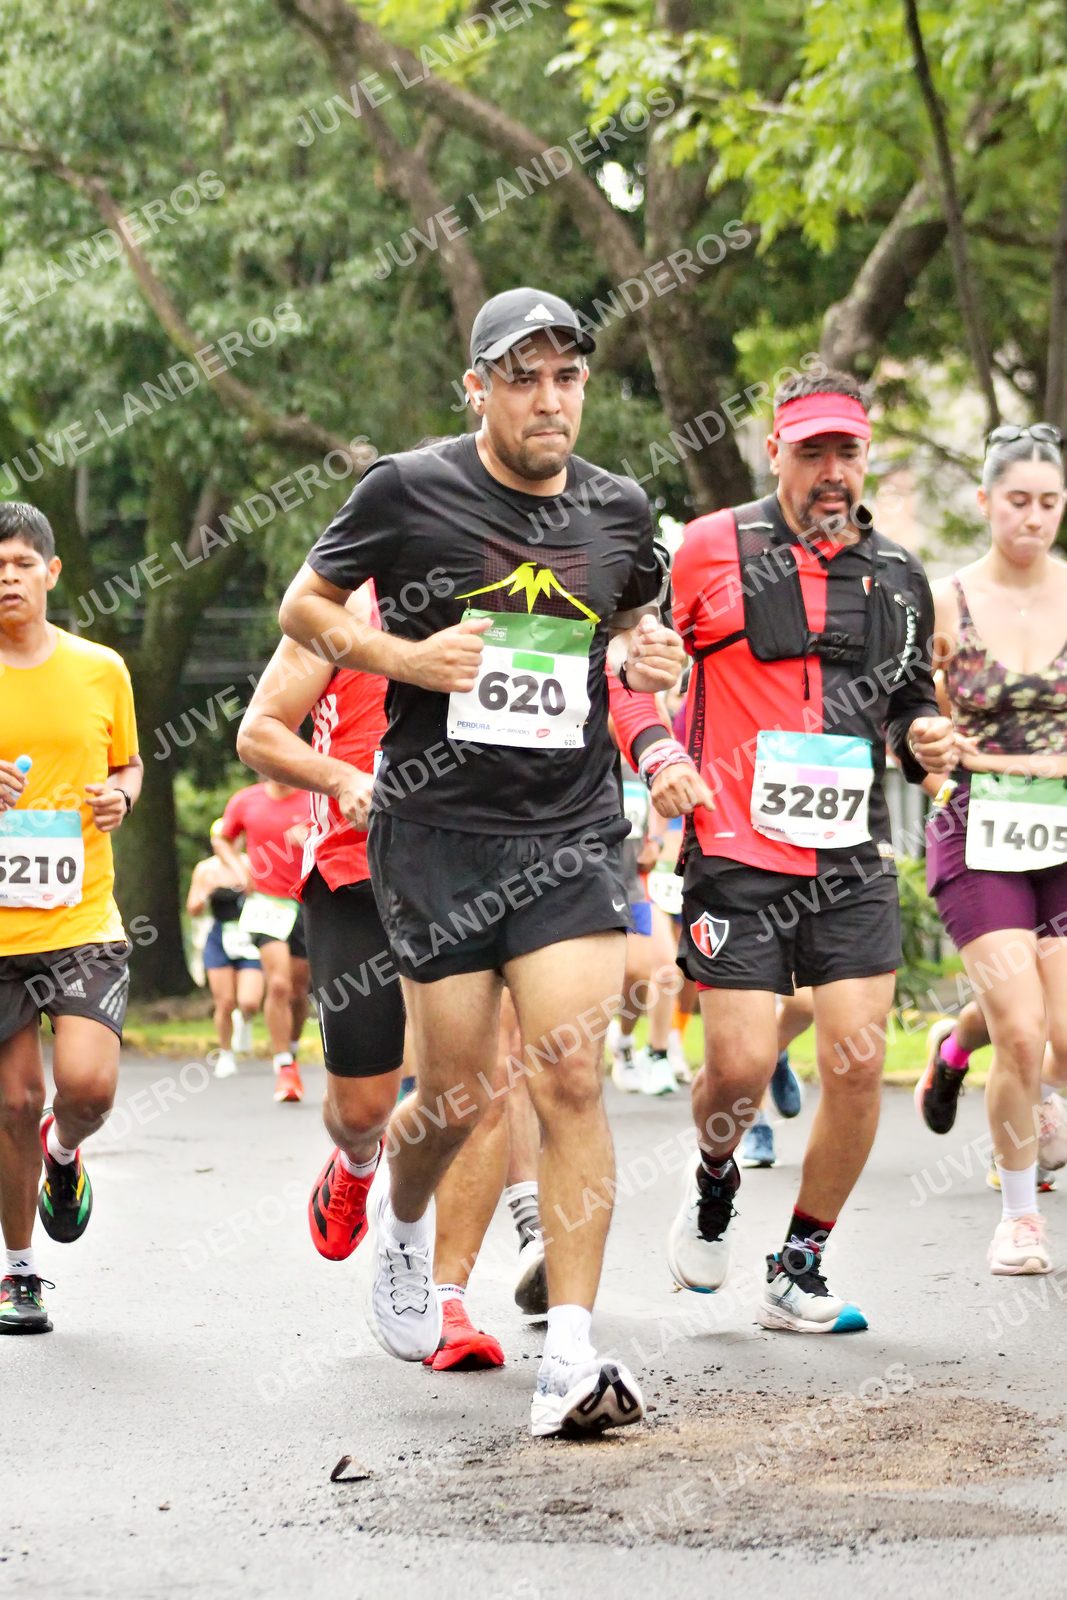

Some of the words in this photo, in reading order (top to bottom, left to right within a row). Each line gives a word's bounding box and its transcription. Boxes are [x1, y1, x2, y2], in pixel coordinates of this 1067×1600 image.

[478, 671, 567, 717] 620
[456, 720, 491, 731] PERDURA
[759, 782, 865, 822] 3287
[980, 819, 1067, 854] 1405
